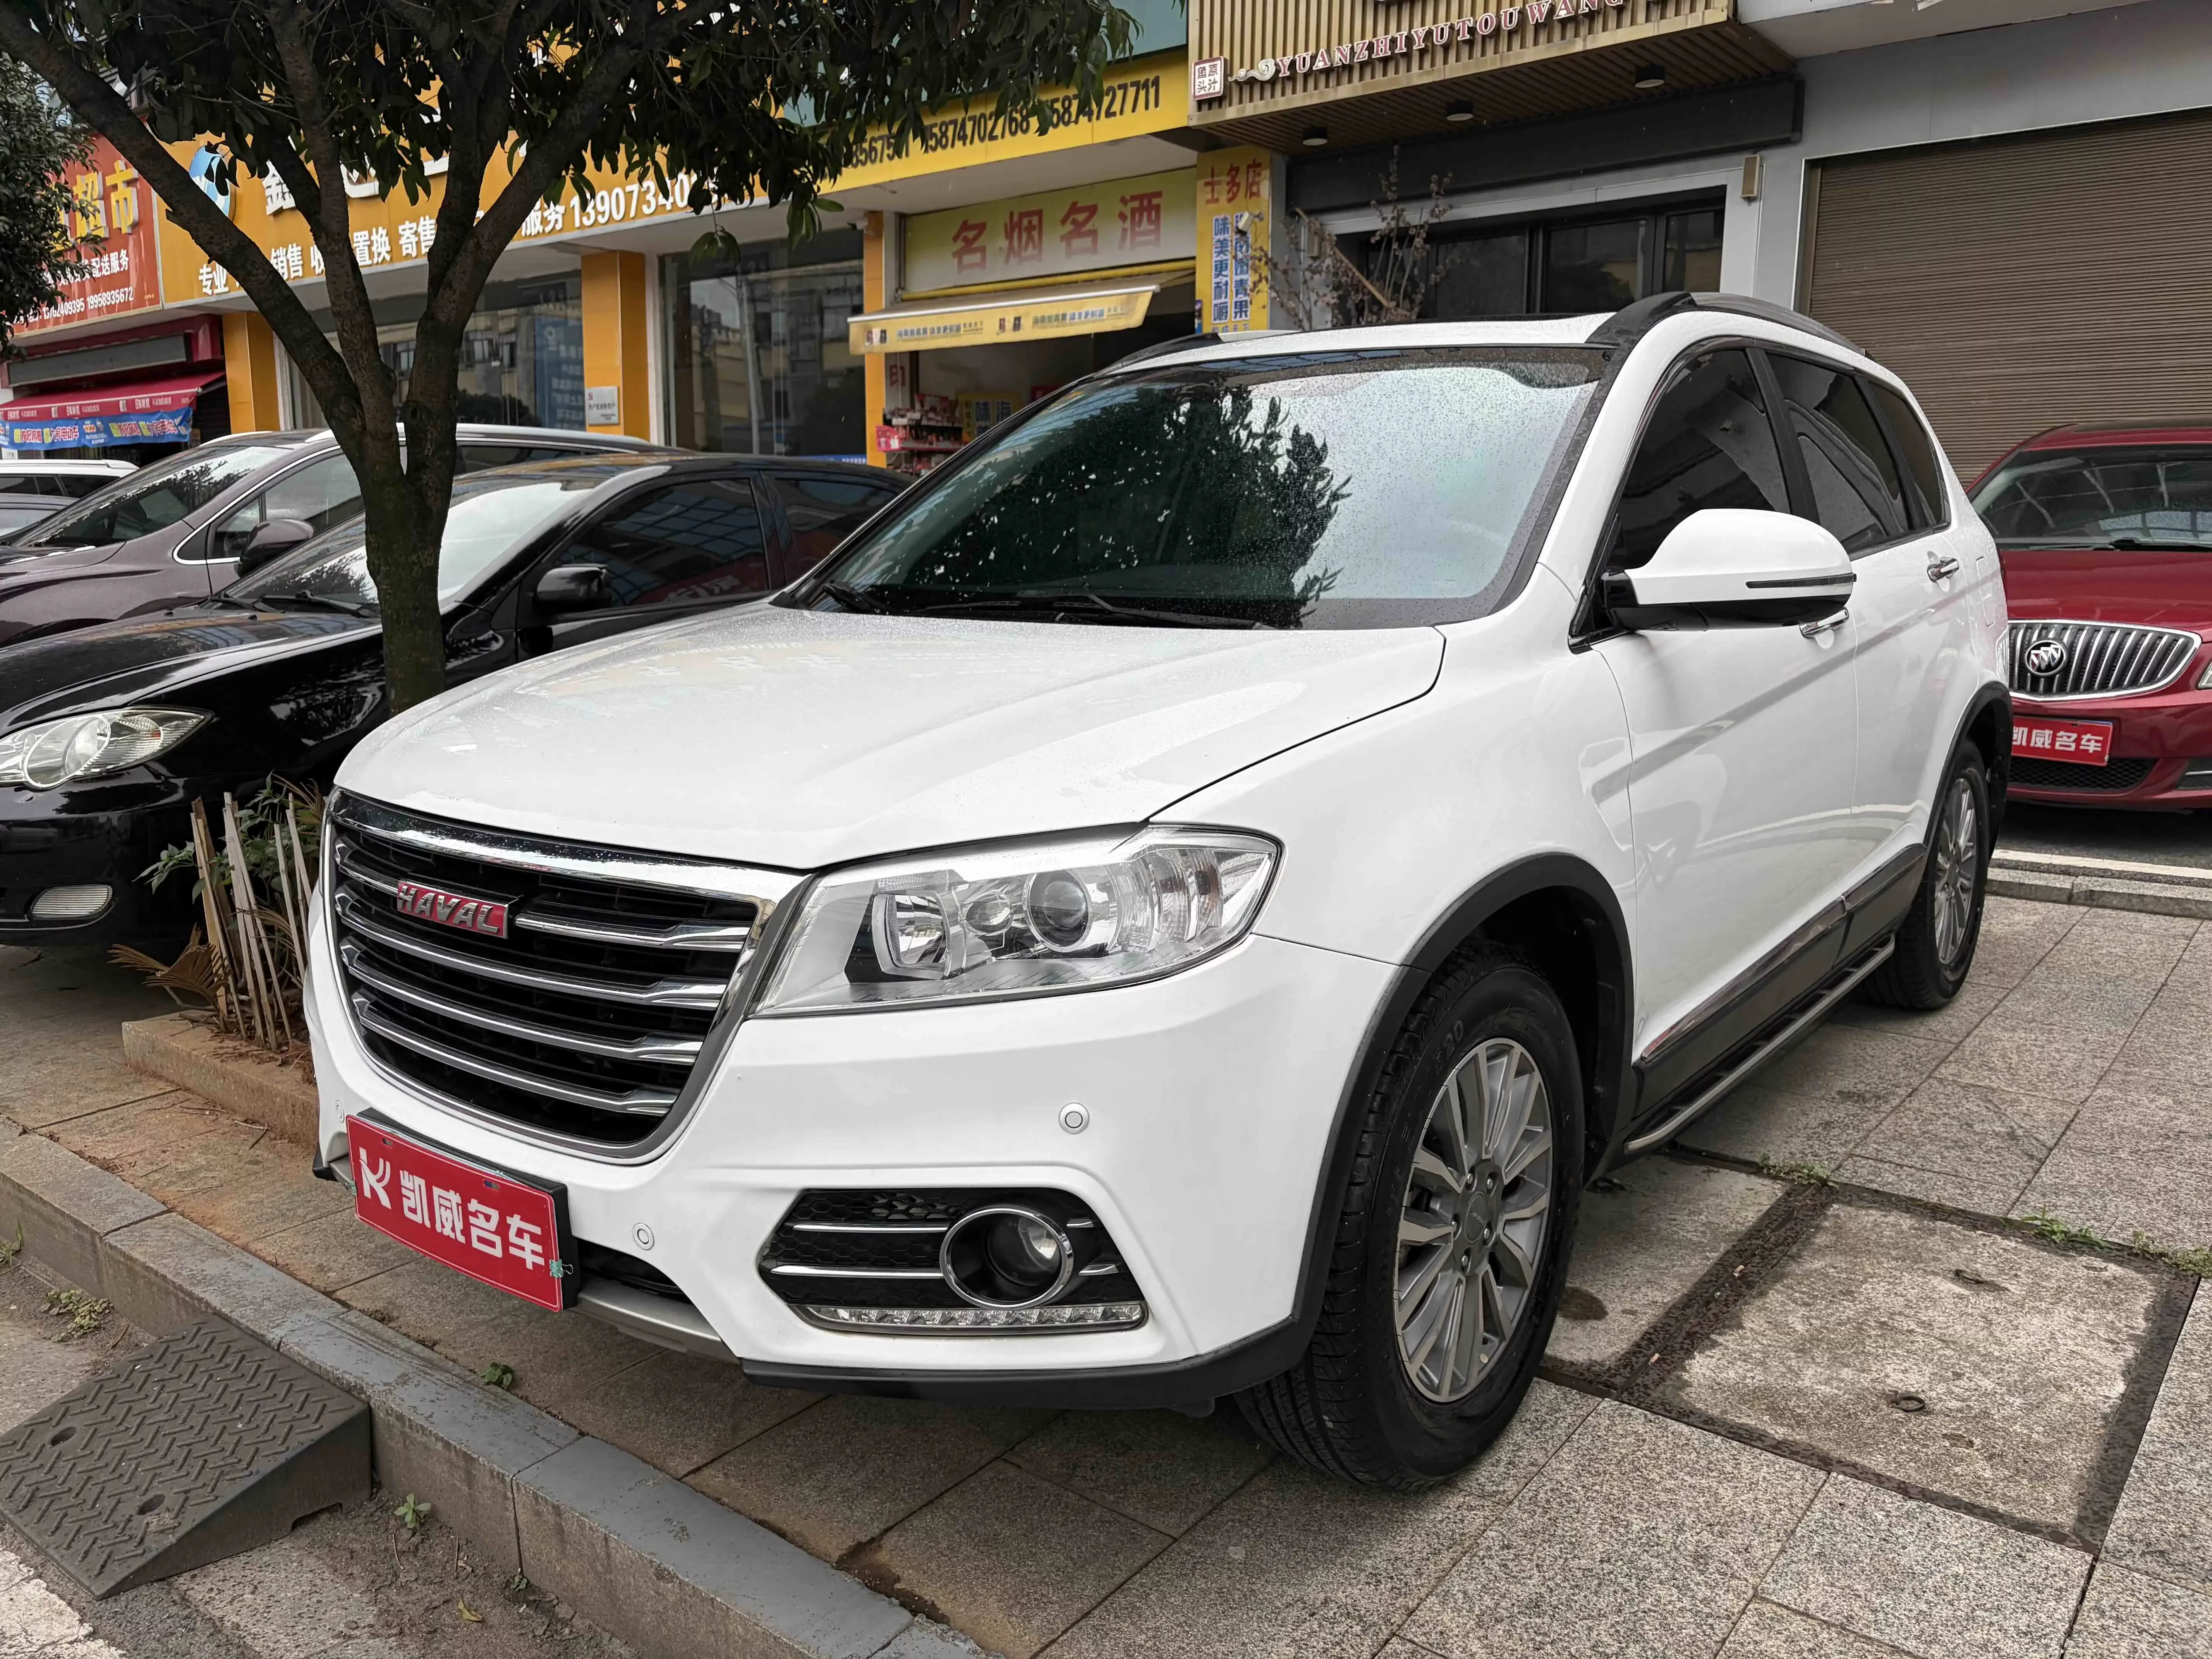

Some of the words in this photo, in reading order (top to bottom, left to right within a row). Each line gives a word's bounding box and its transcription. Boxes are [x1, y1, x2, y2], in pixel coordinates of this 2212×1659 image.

[1204, 158, 1263, 205] 士多店
[198, 263, 230, 295] 专业
[353, 226, 391, 267] 置换
[398, 215, 437, 258] 寄售
[951, 191, 1163, 275] 名烟名酒
[1213, 214, 1230, 322] 味美更耐嚼
[87, 286, 134, 310] 19958935672
[398, 885, 500, 933] HAVAL
[399, 1170, 544, 1270] 凯威名车
